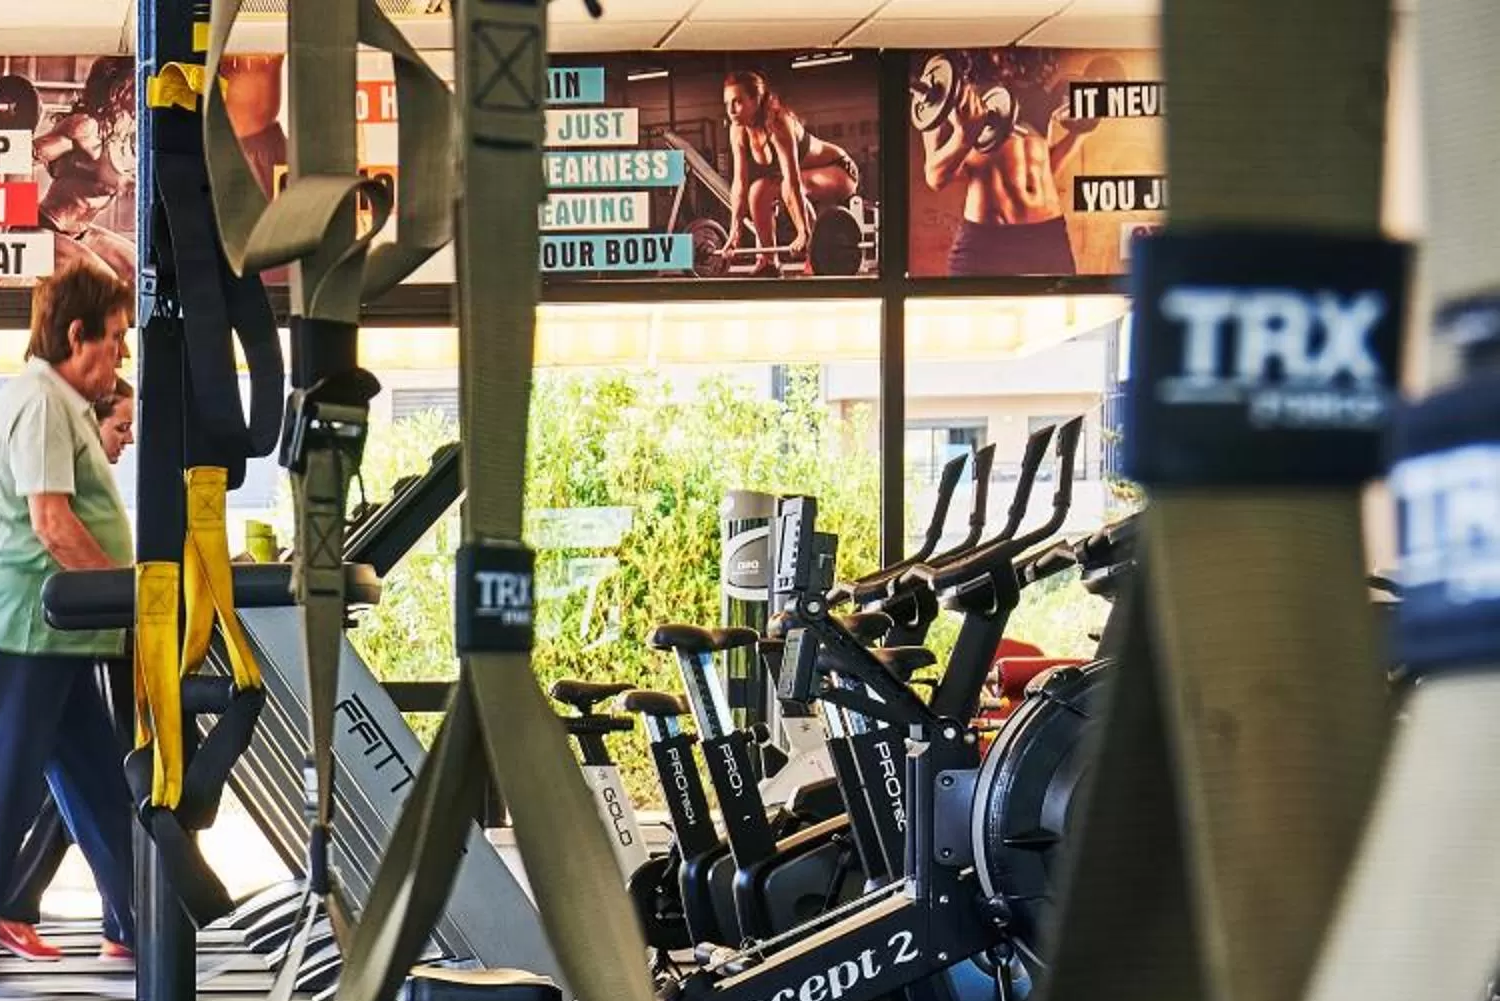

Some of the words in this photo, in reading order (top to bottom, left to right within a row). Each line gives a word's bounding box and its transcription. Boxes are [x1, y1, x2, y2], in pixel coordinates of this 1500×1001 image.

[546, 71, 580, 98] IN
[1074, 87, 1099, 118] IT
[558, 111, 624, 140] JUST
[543, 153, 668, 185] EAKNESS
[1082, 180, 1135, 212] YOU
[605, 237, 674, 265] BODY
[603, 787, 633, 847] GOLD
[887, 929, 920, 965] 2
